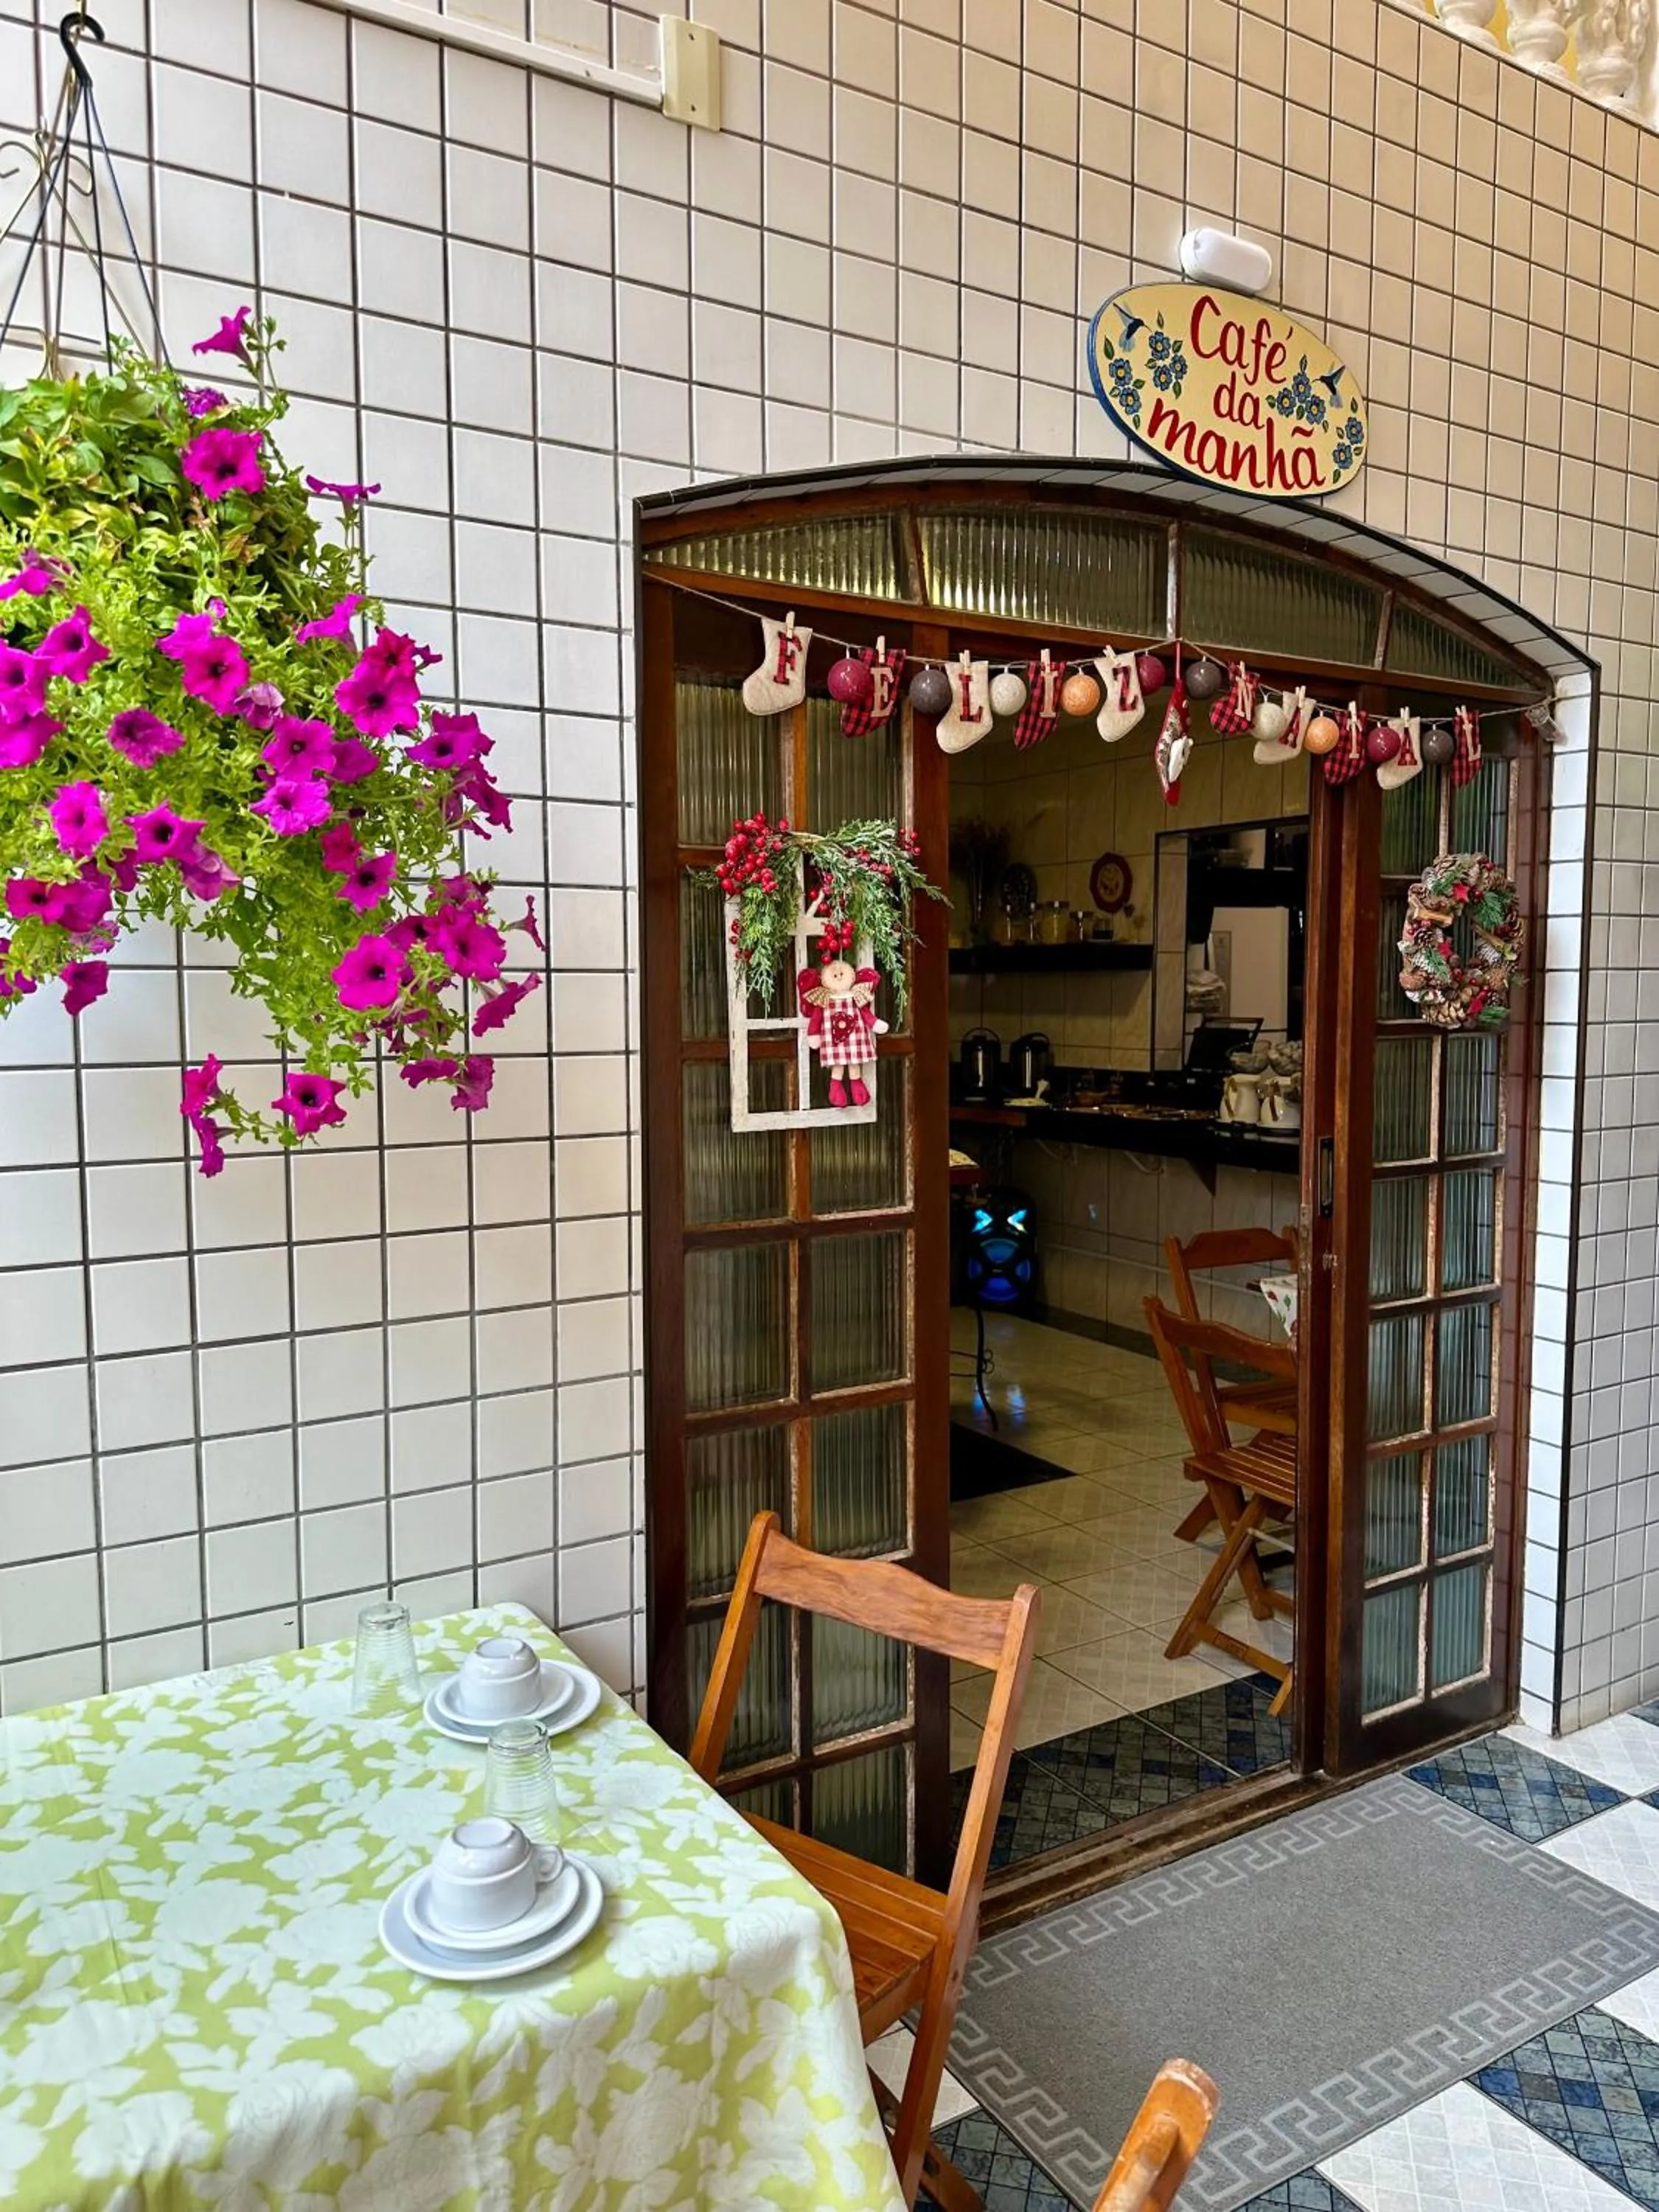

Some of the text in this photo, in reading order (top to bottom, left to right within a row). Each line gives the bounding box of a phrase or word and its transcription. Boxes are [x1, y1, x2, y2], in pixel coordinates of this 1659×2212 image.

[1190, 295, 1293, 386] Café
[1147, 397, 1325, 490] manhã
[1213, 371, 1265, 430] da
[773, 631, 1139, 723] FELIZ
